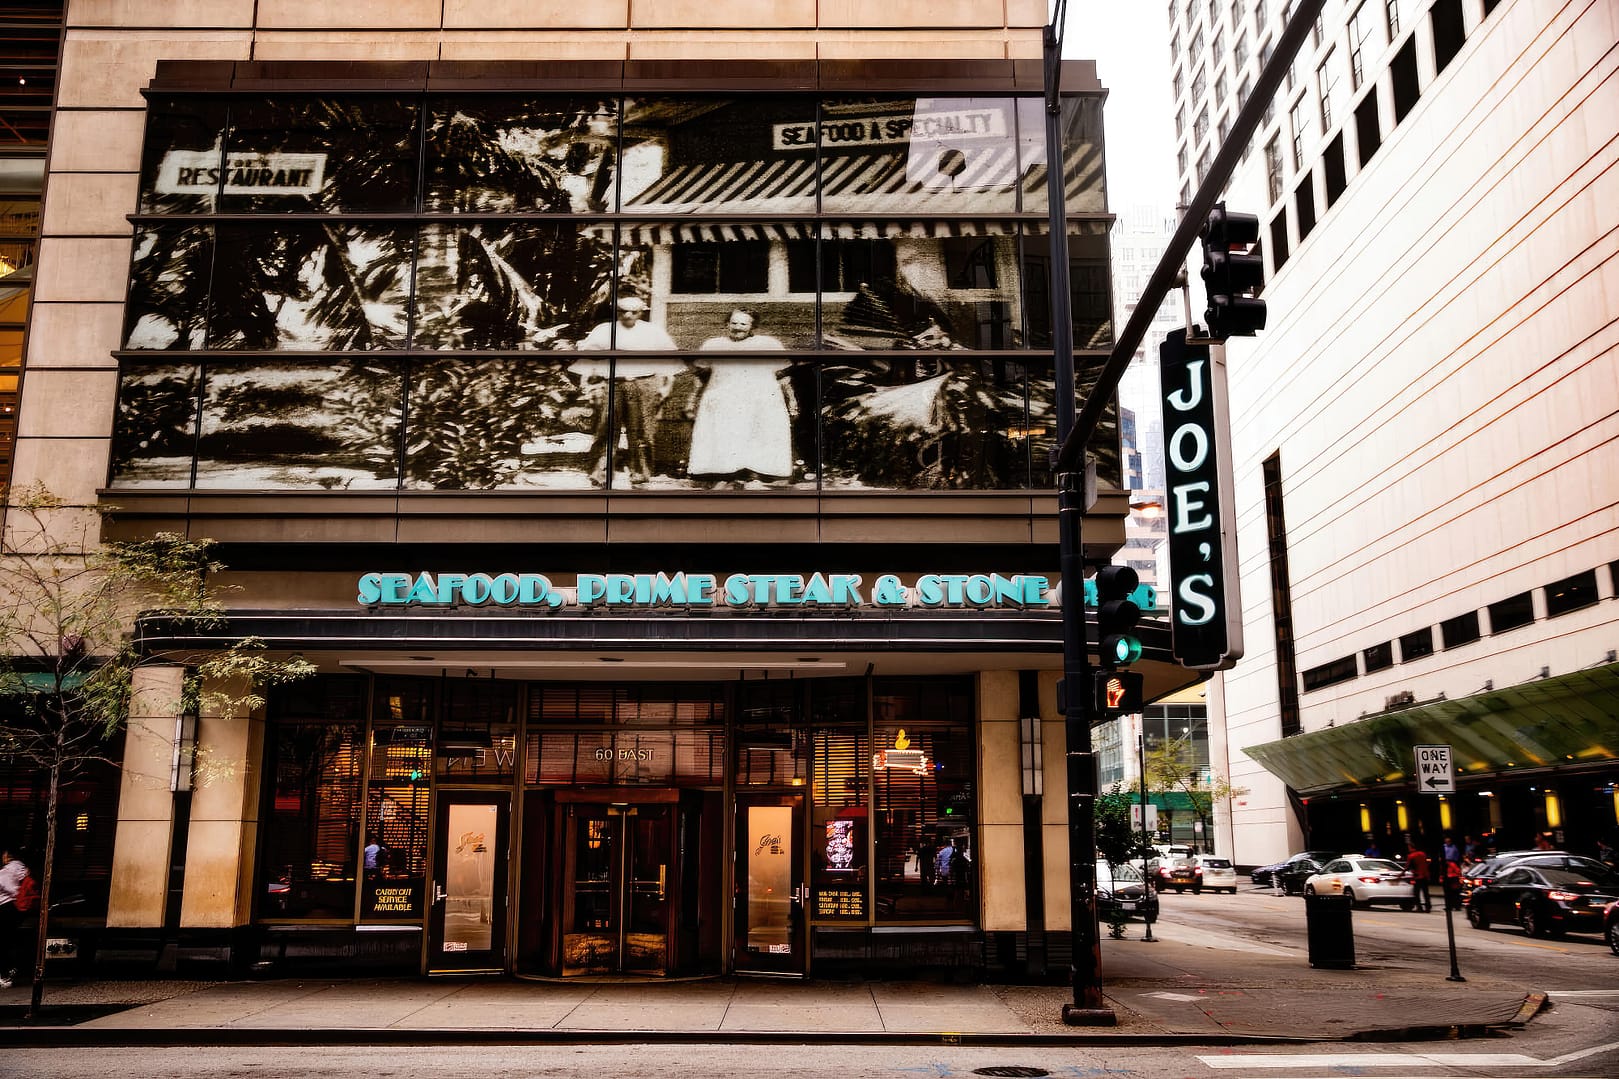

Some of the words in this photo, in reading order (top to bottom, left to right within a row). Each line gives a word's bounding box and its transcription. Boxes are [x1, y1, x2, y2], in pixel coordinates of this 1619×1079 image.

[781, 120, 866, 145] SEAFOOD
[870, 121, 882, 140] A
[886, 113, 993, 140] SPECIALTY
[177, 167, 314, 187] RESTAURANT
[1167, 359, 1217, 625] JOE'S
[358, 571, 564, 608] SEAFOOD,
[577, 571, 715, 605] PRIME
[724, 571, 861, 606] STEAK
[874, 574, 908, 605] &
[917, 573, 1051, 606] STONE
[595, 748, 613, 761] 60
[618, 748, 654, 761] EAST
[1421, 750, 1447, 761] ONE
[1421, 763, 1448, 773] WAY
